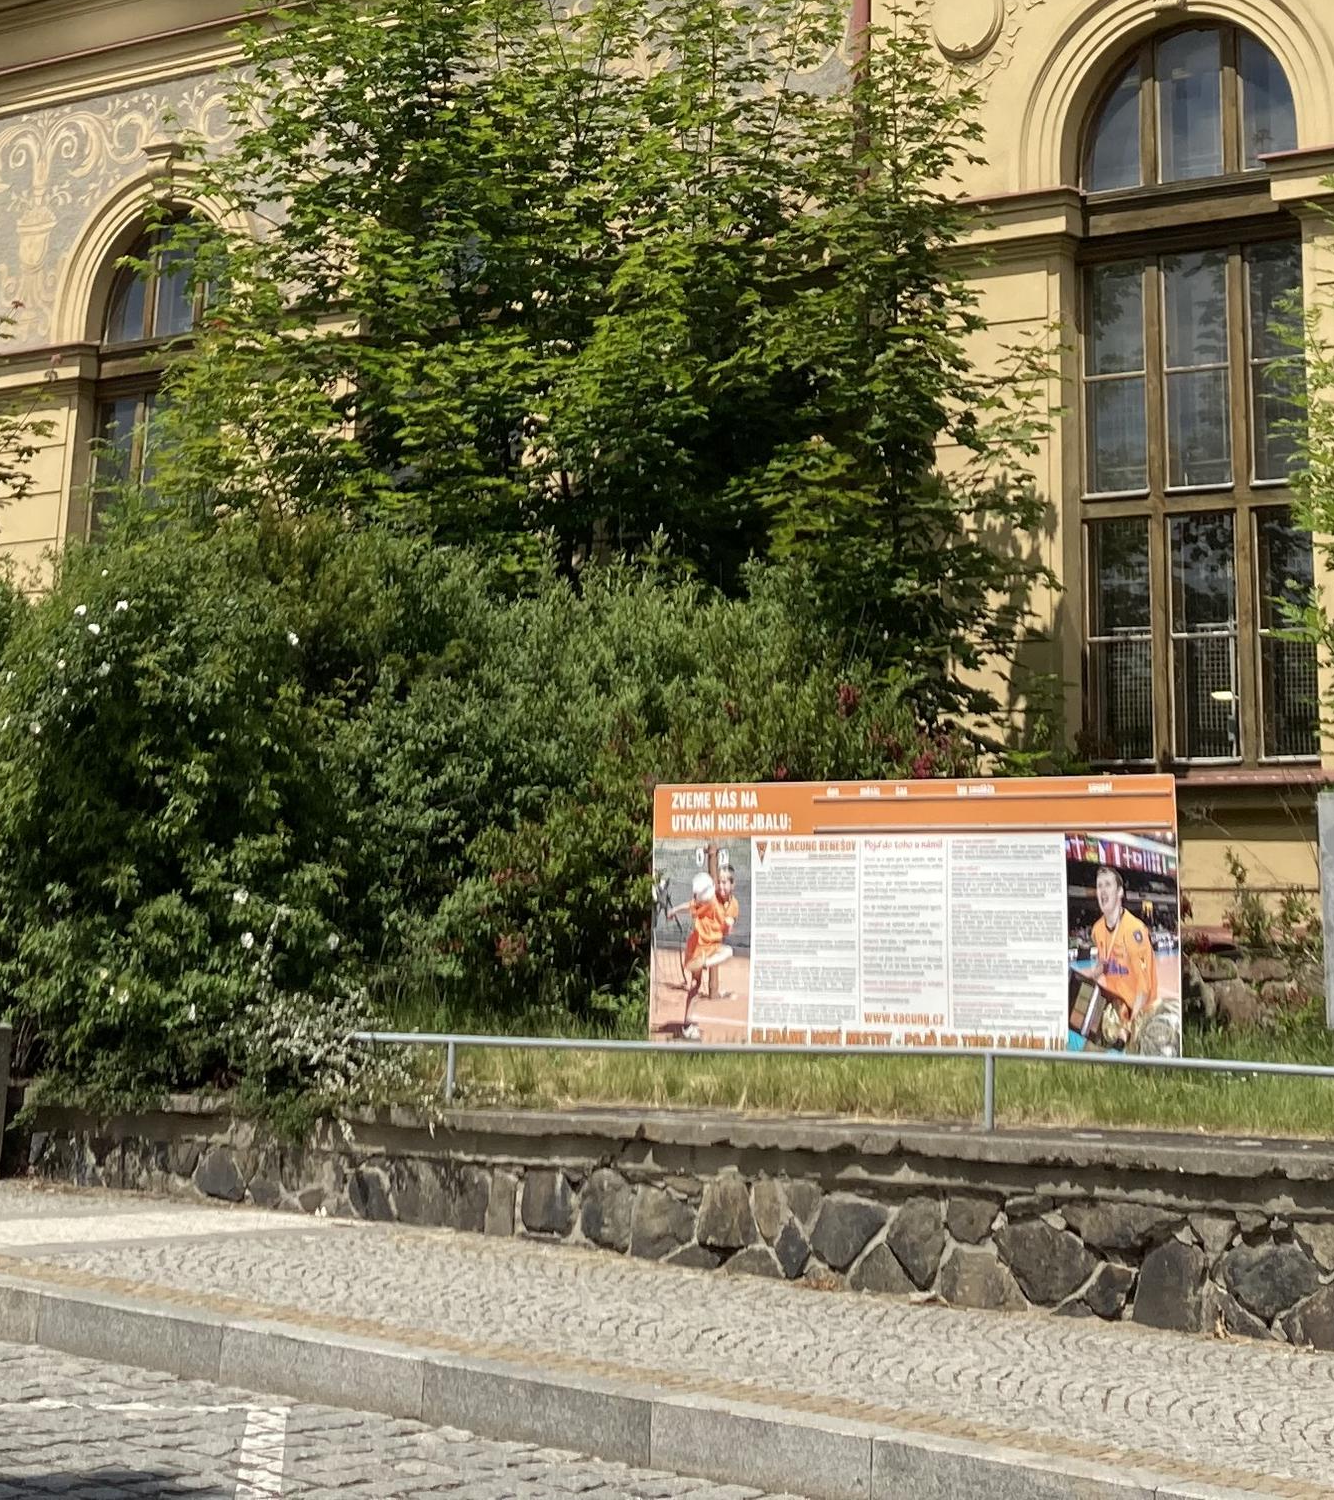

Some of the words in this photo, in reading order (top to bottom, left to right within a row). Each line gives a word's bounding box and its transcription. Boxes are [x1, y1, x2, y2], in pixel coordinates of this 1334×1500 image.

[671, 791, 711, 809] ZVEME
[714, 787, 737, 809] VÁS
[741, 791, 758, 808] NA
[671, 810, 715, 832] UTKÁNÍ
[718, 813, 792, 831] NOHEJBALU:
